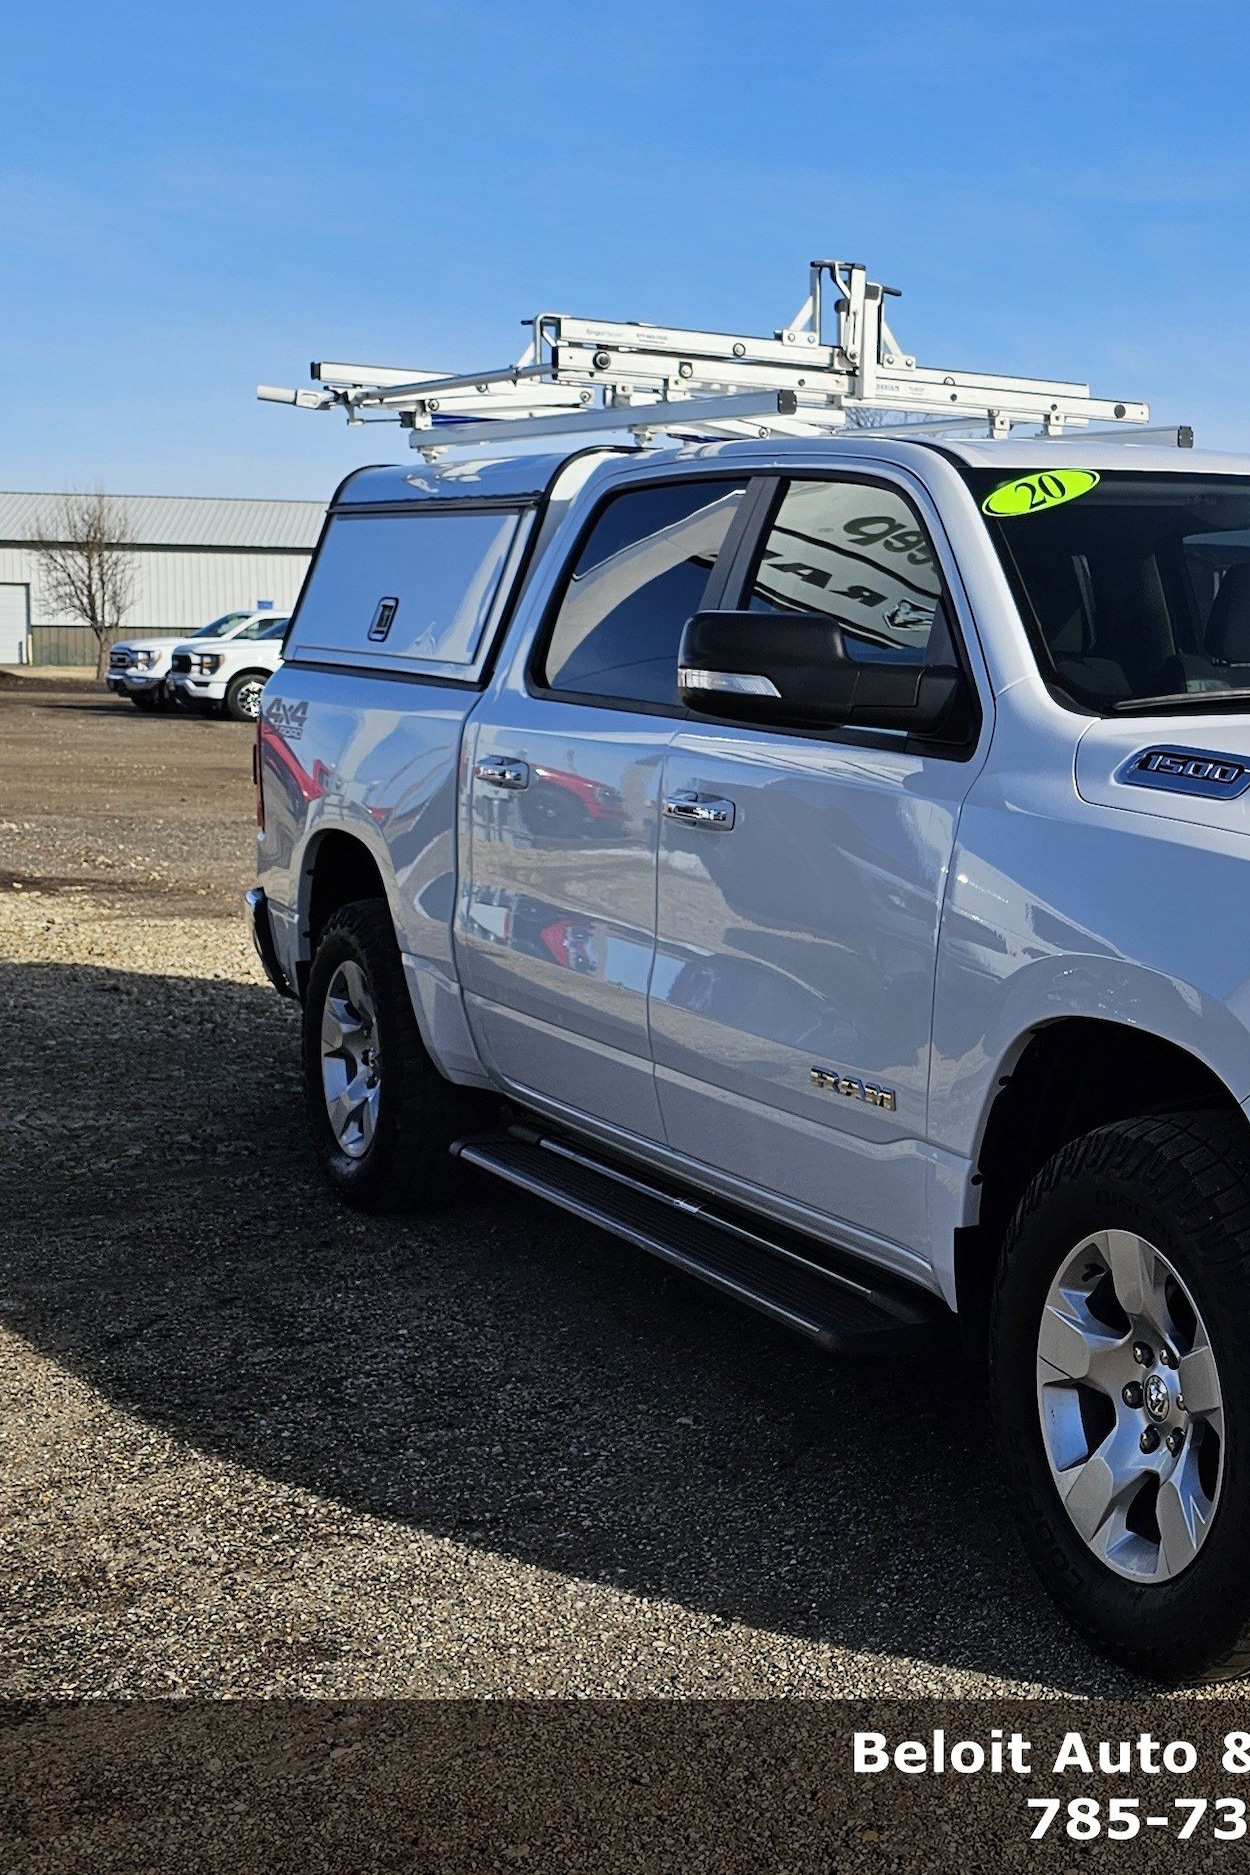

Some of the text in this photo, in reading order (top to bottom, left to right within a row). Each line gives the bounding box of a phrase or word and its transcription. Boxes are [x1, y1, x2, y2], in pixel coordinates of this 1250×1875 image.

[1014, 474, 1066, 510] 20
[1149, 755, 1240, 782] 1500
[810, 1064, 897, 1112] RAM
